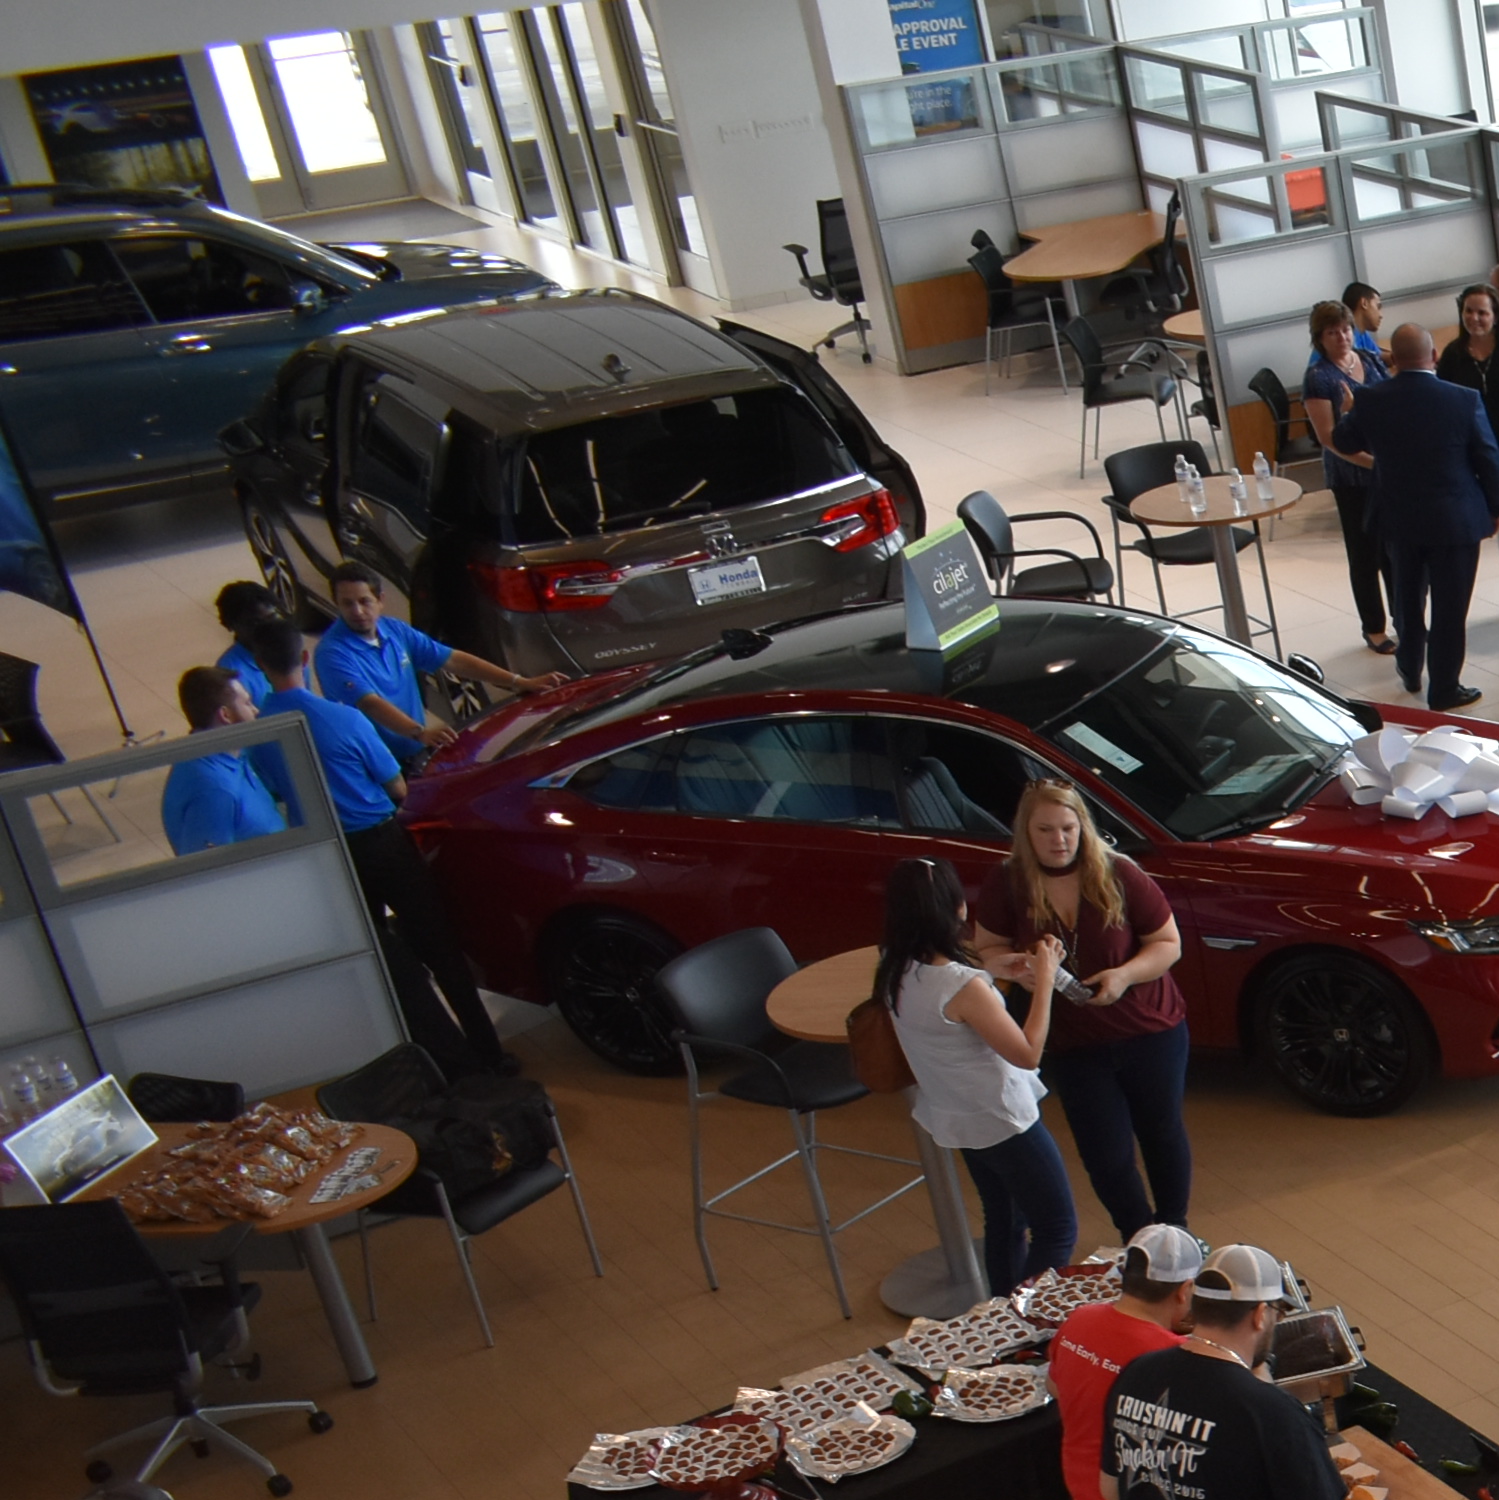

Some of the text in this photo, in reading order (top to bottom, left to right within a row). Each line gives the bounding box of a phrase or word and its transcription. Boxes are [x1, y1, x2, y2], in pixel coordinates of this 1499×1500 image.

[893, 17, 968, 36] APPROVAL
[912, 33, 958, 50] EVENT
[718, 569, 759, 584] Honda
[933, 563, 969, 595] cilajet
[594, 642, 657, 660] ODYSSEY
[1101, 1358, 1122, 1374] Eat
[1117, 1394, 1217, 1442] CRUSHIN' IT
